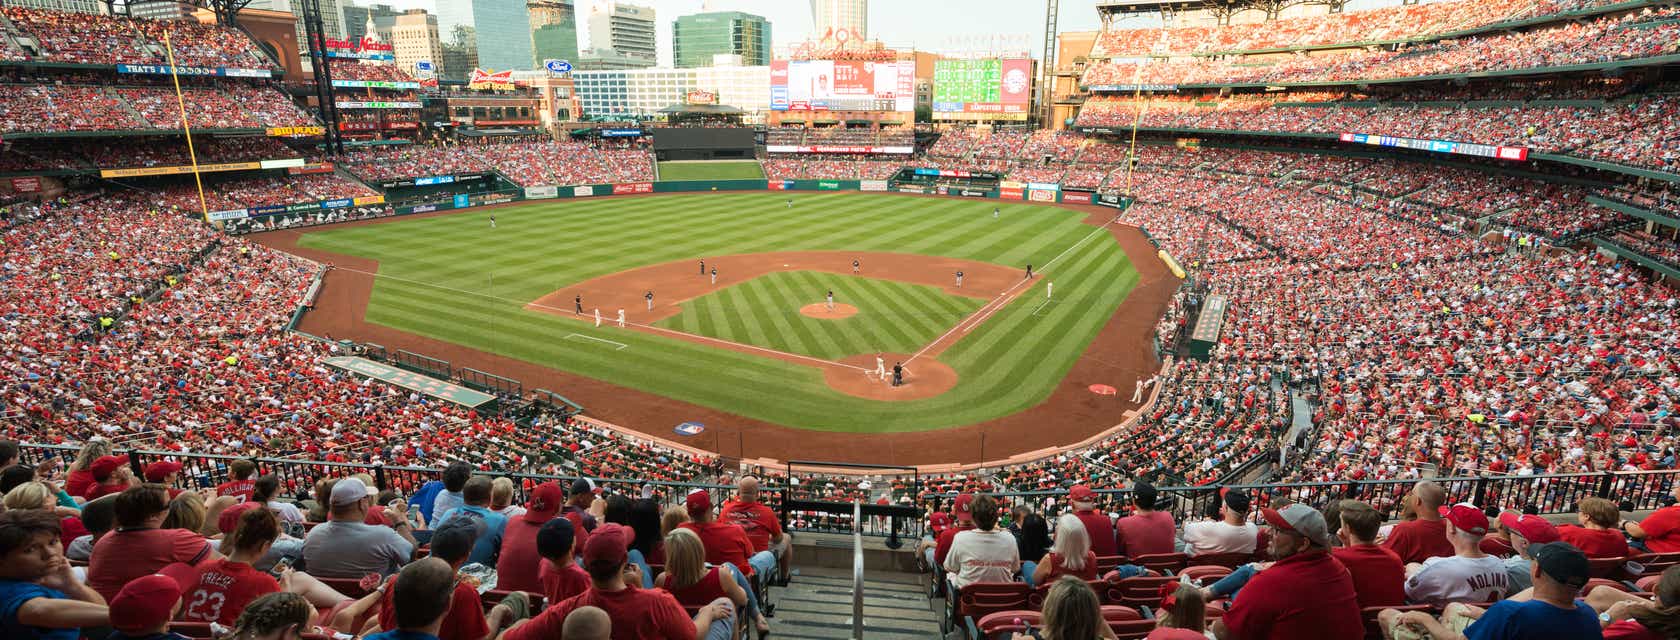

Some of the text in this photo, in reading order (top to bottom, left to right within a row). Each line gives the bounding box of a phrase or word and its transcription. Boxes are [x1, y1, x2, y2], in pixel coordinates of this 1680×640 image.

[355, 36, 392, 52] Nation
[126, 65, 156, 73] THAT'S
[551, 61, 568, 71] Ford
[274, 127, 292, 136] BIG
[200, 571, 234, 588] FREESE
[1466, 572, 1507, 592] MOLINA
[189, 589, 225, 622] 23
